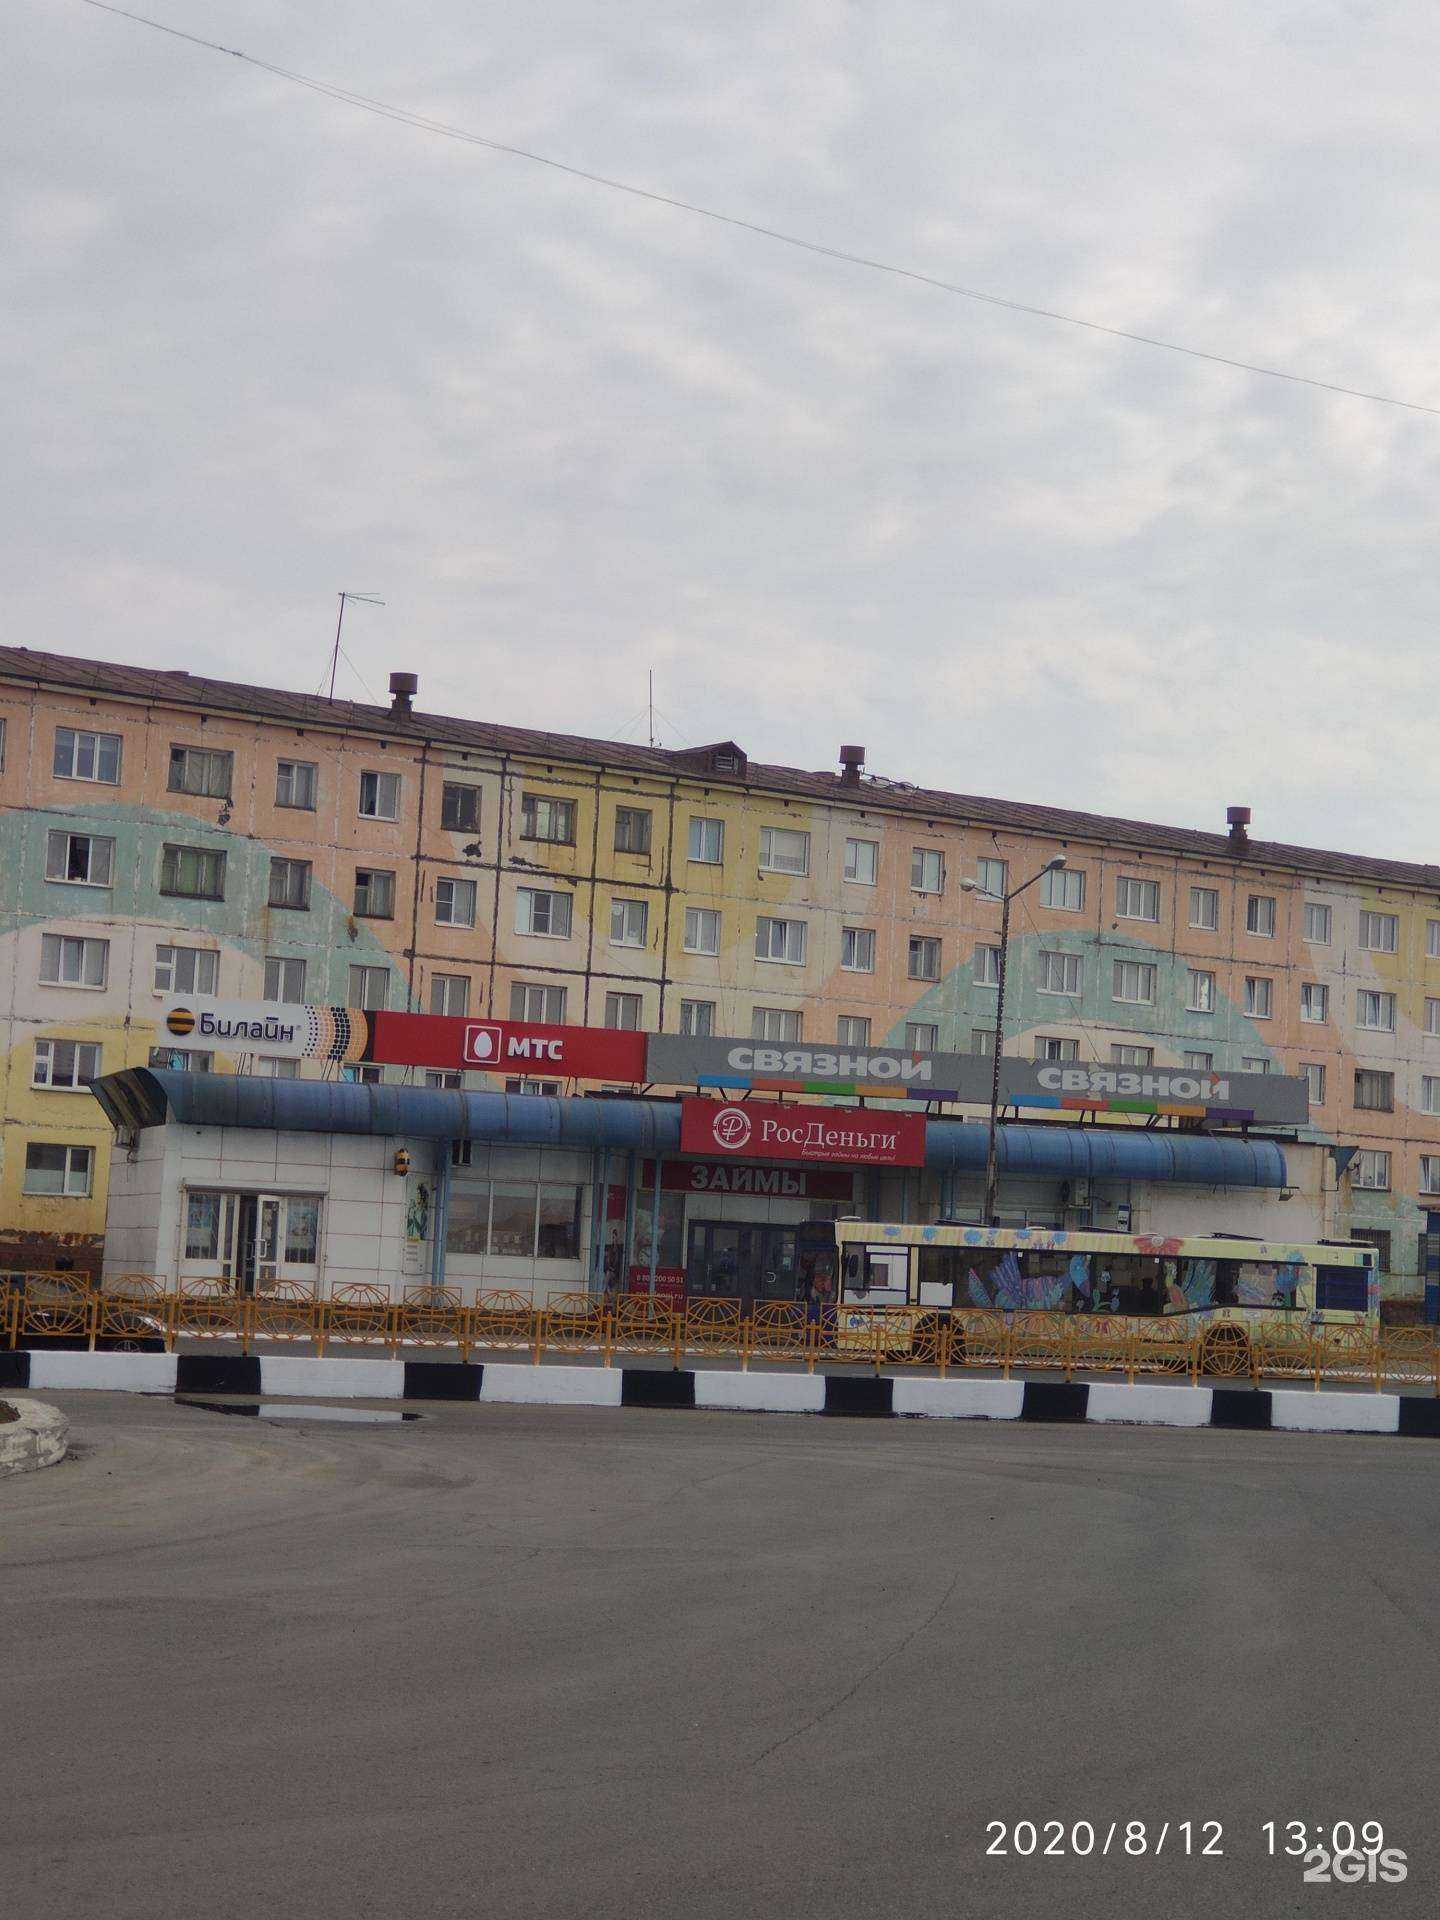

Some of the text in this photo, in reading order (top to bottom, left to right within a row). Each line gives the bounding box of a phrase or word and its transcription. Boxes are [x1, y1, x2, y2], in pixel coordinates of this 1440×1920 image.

[200, 1012, 295, 1041] Билайн
[507, 1036, 564, 1060] МТС
[761, 1119, 897, 1150] РосДеньги
[690, 1165, 808, 1195] ЗАЙМЫ
